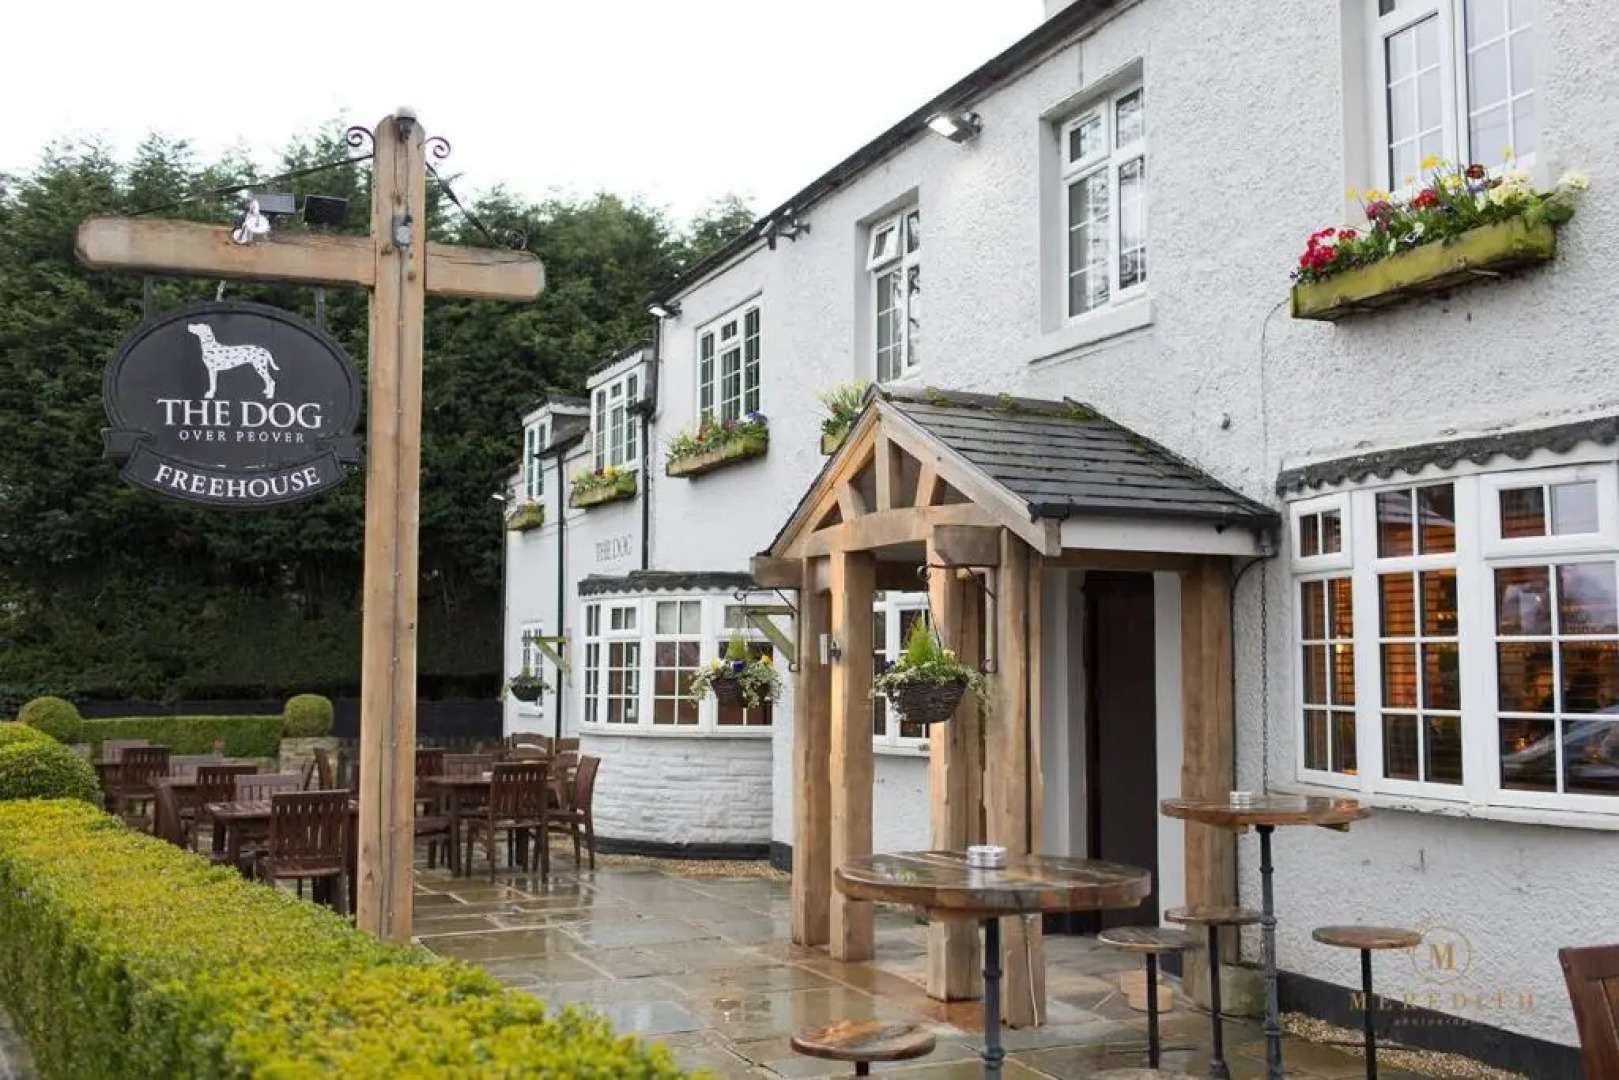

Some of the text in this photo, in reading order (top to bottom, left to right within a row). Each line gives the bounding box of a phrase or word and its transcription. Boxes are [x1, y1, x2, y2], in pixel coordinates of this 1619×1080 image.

[157, 399, 323, 428] THE DOG
[178, 429, 305, 443] OVER PEOVER
[154, 464, 321, 498] FREEHOUSE
